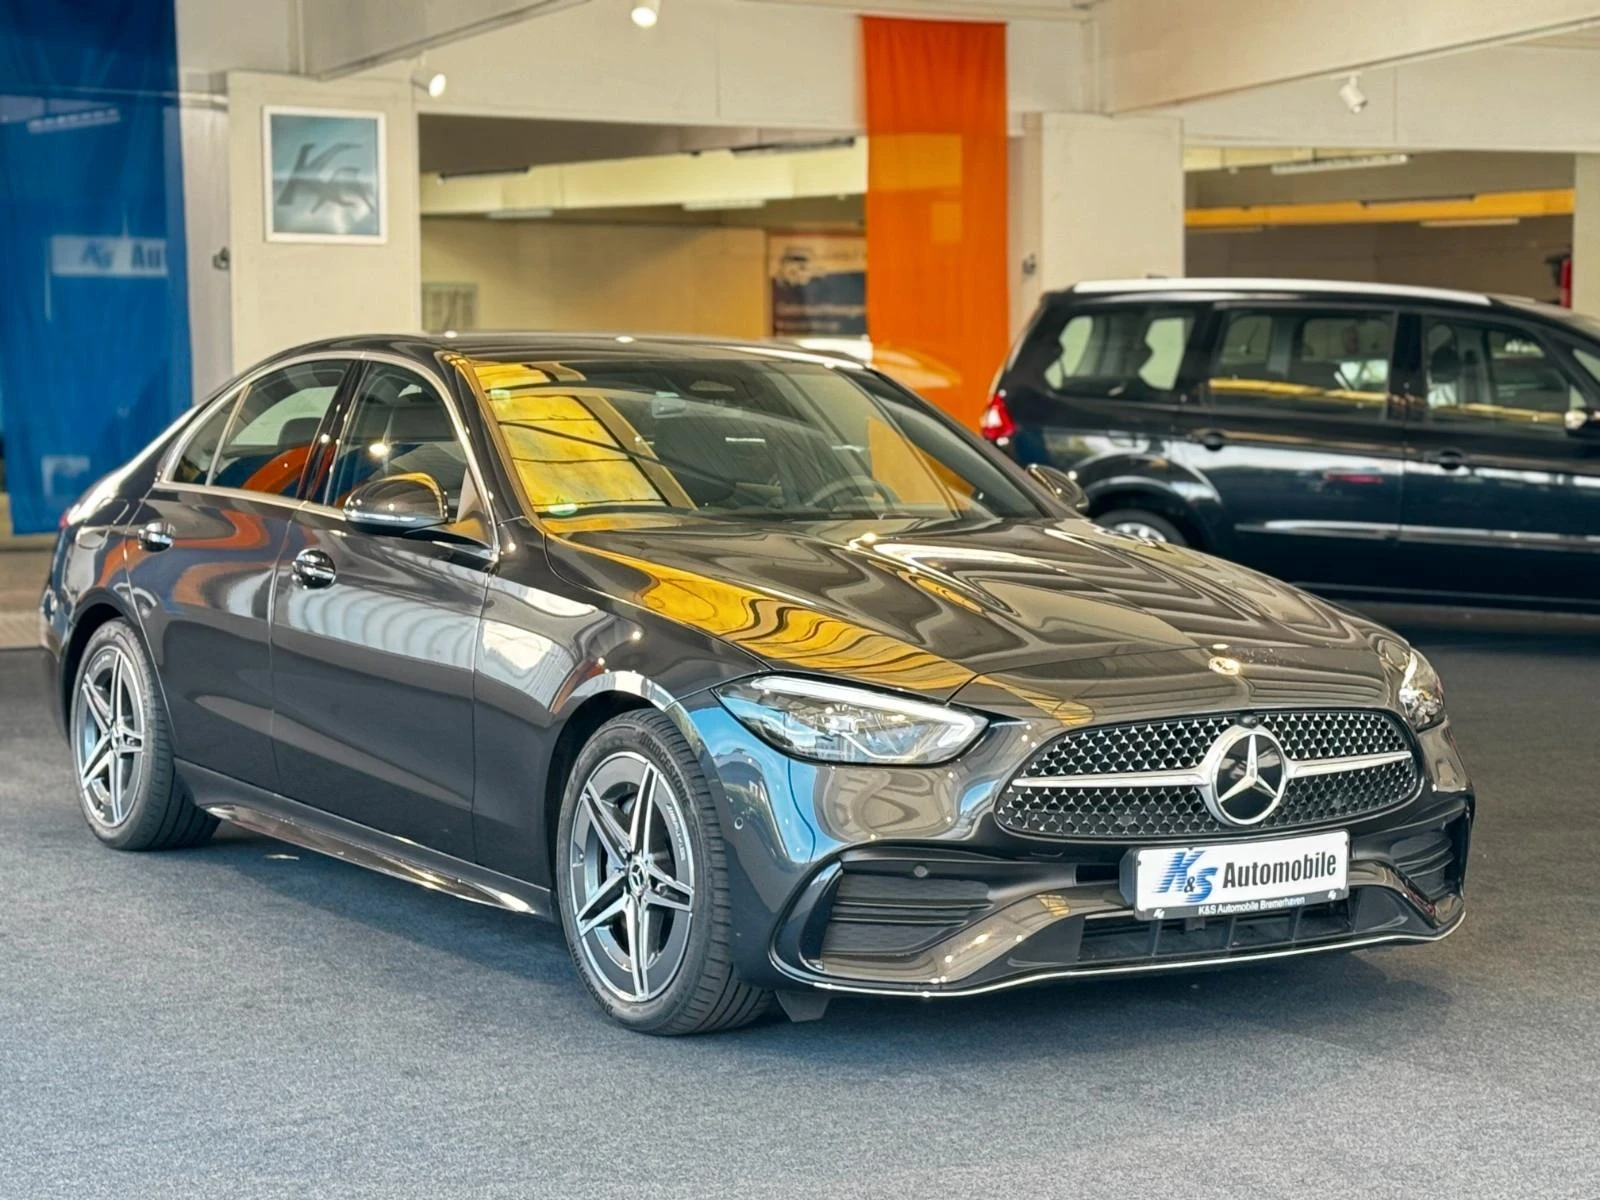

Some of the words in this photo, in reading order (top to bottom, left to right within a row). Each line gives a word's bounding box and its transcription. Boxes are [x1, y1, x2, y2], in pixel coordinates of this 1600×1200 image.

[1152, 850, 1219, 904] K&S
[1222, 851, 1337, 889] Automobile
[1198, 904, 1216, 915] K&S
[1217, 901, 1259, 913] Automobile
[1260, 897, 1305, 910] Bremerhaven
